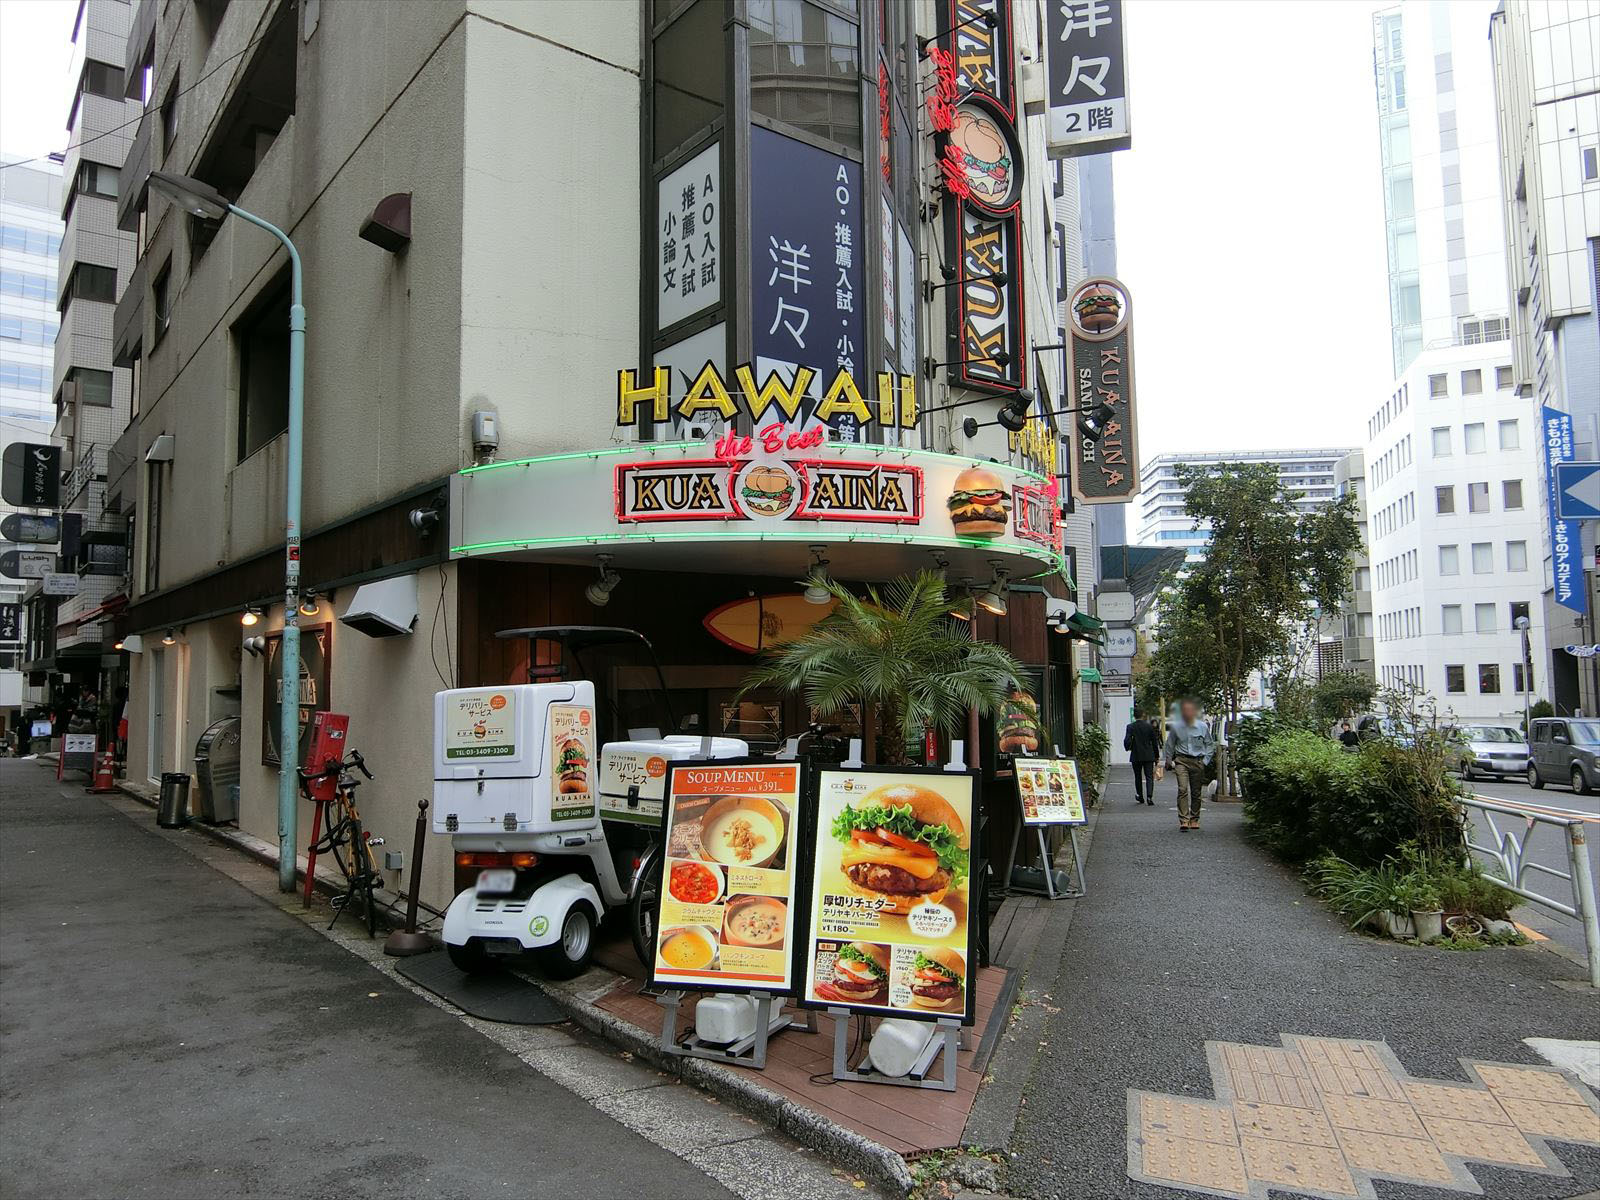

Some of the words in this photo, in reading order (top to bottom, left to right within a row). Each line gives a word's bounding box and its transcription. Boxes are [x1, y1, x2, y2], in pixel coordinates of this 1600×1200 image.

[1060, 0, 1114, 97] 洋々
[1065, 107, 1114, 133] 2階
[682, 183, 696, 297] 推薦入試
[701, 174, 716, 288] AO入試
[663, 211, 677, 293] 小論文
[768, 235, 813, 349] 洋々
[964, 223, 1006, 377] KUA
[617, 359, 917, 430] HAWAII
[1080, 368, 1095, 462] SANDCH
[715, 428, 752, 458] the
[760, 422, 824, 453] Best
[631, 473, 718, 512] KUA
[808, 465, 908, 512] AINA
[460, 702, 489, 711] デリバリー
[469, 709, 492, 717] サービス
[555, 717, 579, 727] デリバリー
[570, 728, 589, 736] サービス
[608, 761, 644, 773] デリバリー
[619, 773, 648, 785] サービス
[687, 771, 722, 784] SOUP
[724, 770, 765, 783] MENU
[823, 895, 895, 910] 厚切りチェダー
